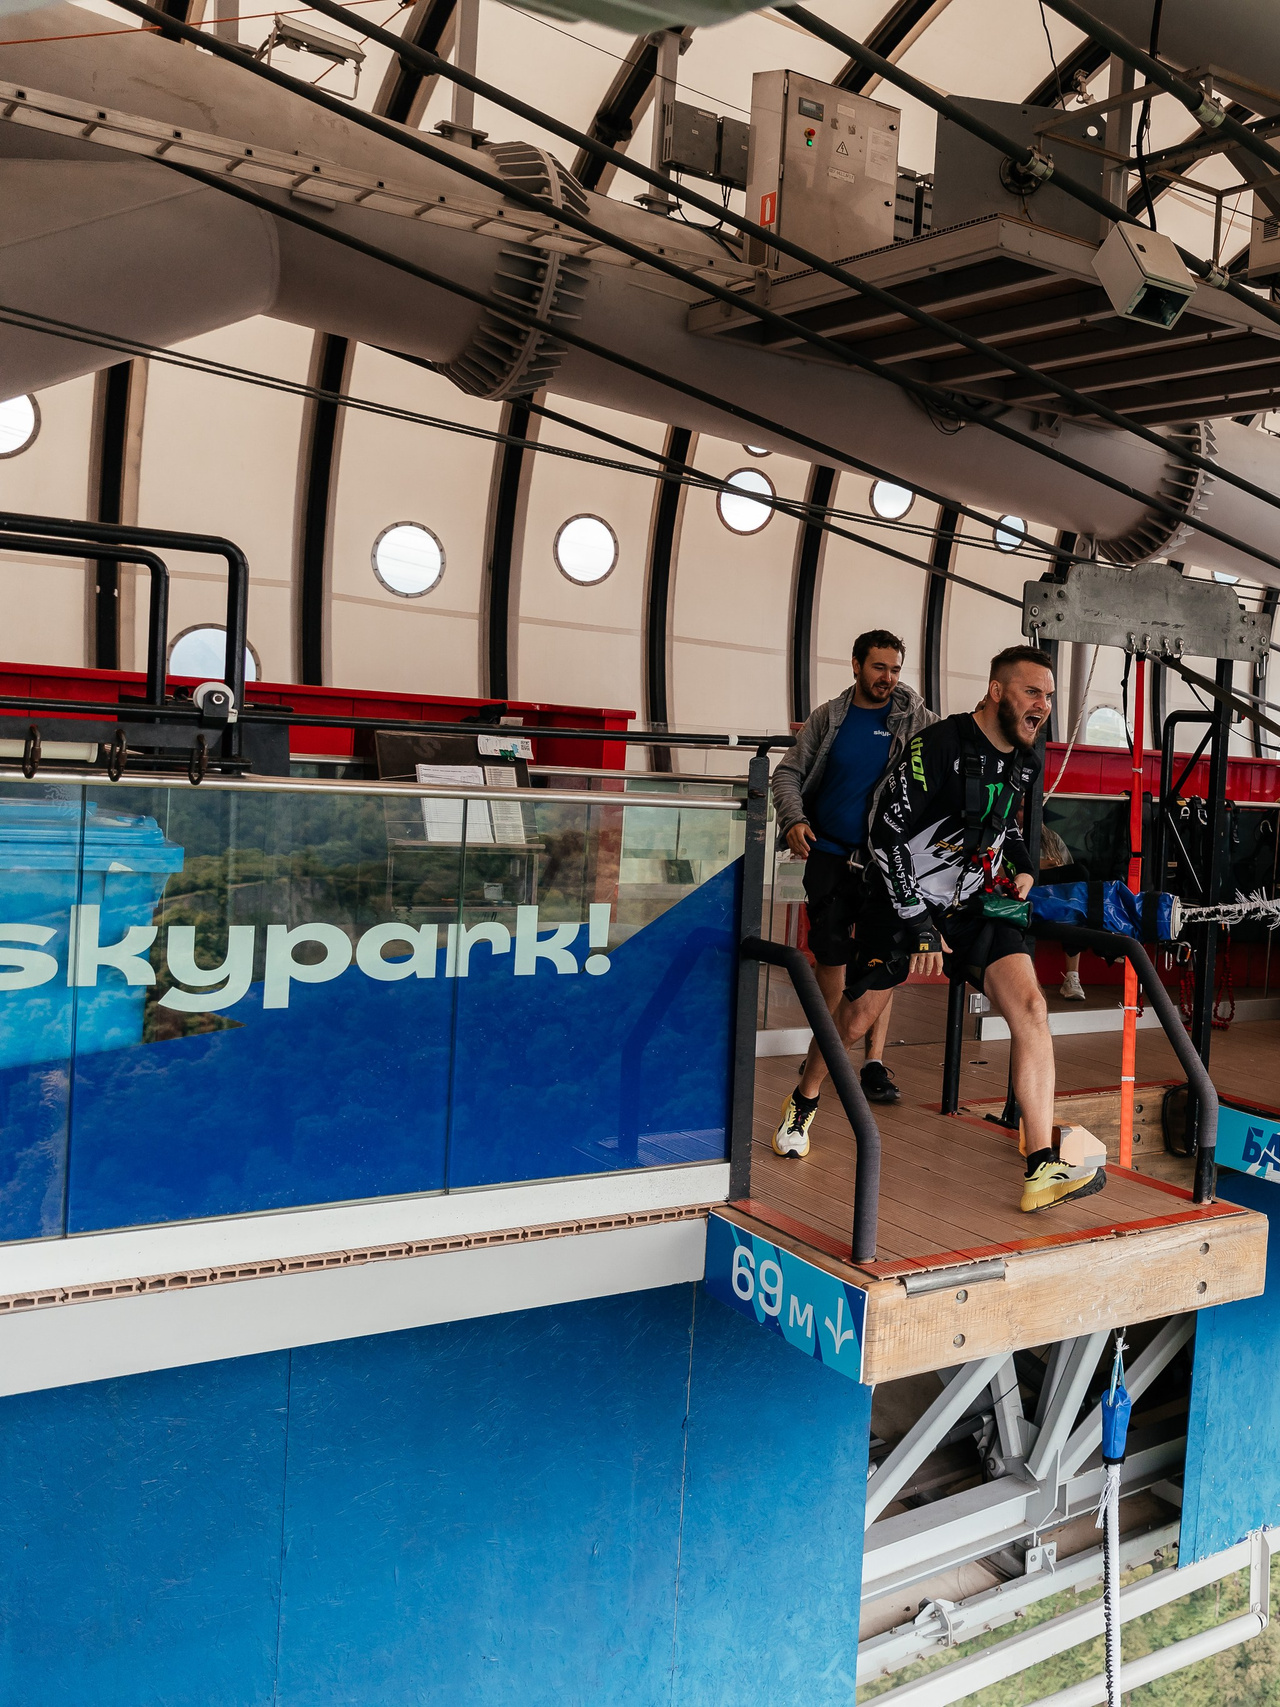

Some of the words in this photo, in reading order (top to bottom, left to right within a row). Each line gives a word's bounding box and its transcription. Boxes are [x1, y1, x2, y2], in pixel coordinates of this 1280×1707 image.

[910, 736, 928, 792] thor
[892, 845, 912, 898] MONSTER
[0, 902, 612, 1013] skypark!
[731, 1245, 784, 1317] 69
